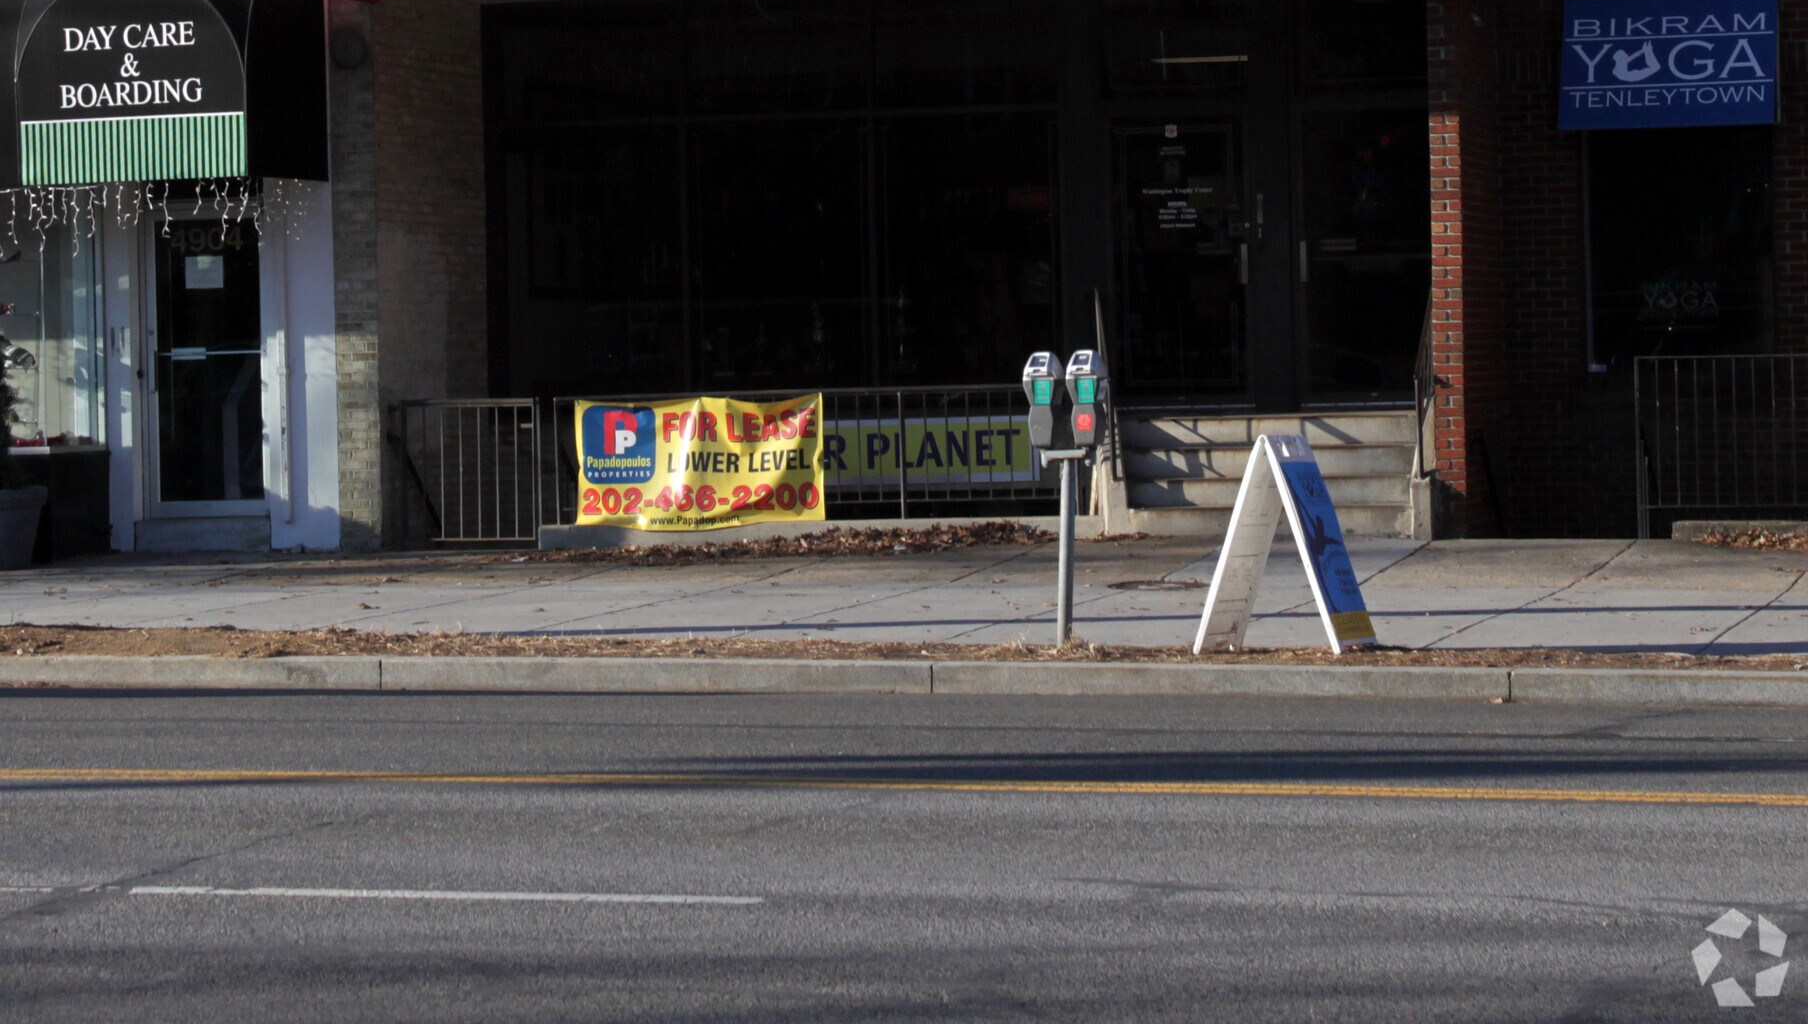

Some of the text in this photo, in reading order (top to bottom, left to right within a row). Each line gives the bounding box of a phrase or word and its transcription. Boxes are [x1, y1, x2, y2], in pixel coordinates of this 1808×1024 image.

[64, 21, 195, 52] DAY CARE
[1572, 12, 1767, 38] BIKRAM
[120, 53, 140, 77] &
[60, 78, 203, 108] BOARDING
[1570, 85, 1766, 108] TENLEYTOWN
[171, 227, 244, 252] 4904
[663, 408, 817, 443] FOR LEASE
[748, 448, 811, 473] LEVEL
[867, 429, 1021, 469] PLANET
[587, 455, 651, 470] Papadopoulos
[587, 470, 651, 478] PROPERTIES
[582, 483, 820, 515] 202-466-2200
[650, 514, 741, 527] www.Papadop.com
